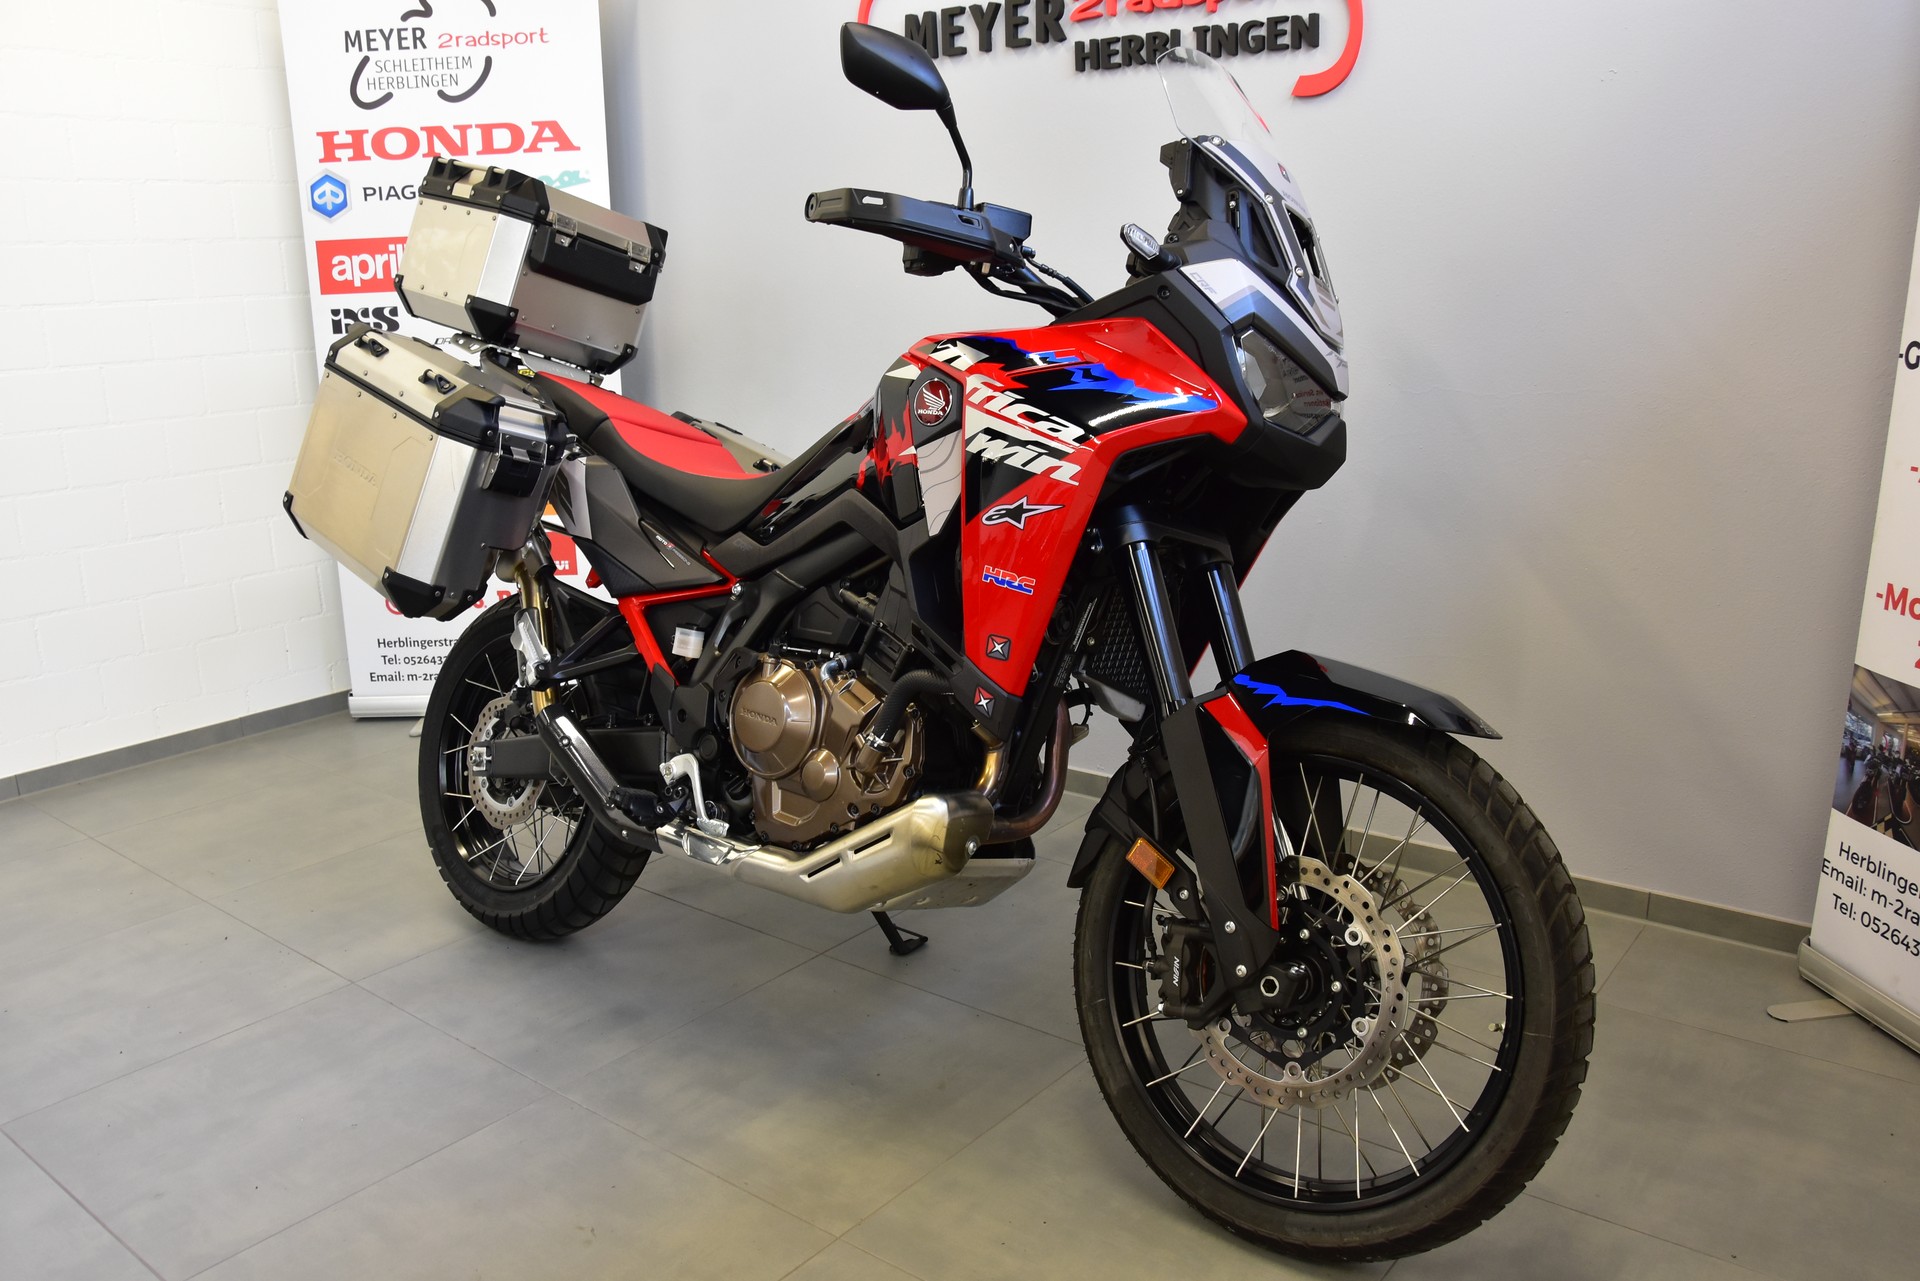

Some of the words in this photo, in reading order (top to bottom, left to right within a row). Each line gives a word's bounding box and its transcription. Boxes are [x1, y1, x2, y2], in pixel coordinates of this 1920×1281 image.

[344, 27, 428, 53] MEYER
[438, 27, 550, 49] 2radsport
[904, 0, 1068, 59] MEYER
[1074, 12, 1321, 72] HERBLINGEN
[374, 55, 473, 74] SCHLEITHEIM
[366, 73, 460, 91] HERBLINGEN
[315, 119, 582, 164] HONDA
[362, 184, 422, 202] PIAG
[331, 243, 408, 287] april
[917, 408, 944, 417] HONDA
[982, 564, 1036, 596] HRC
[381, 654, 401, 665] Tel:
[403, 655, 447, 666] 052643
[369, 671, 405, 682] Email:
[741, 707, 778, 726] HONDA
[1821, 858, 1867, 897] Email:
[1838, 841, 1920, 898] Herblinge
[1832, 892, 1857, 921] Tel:
